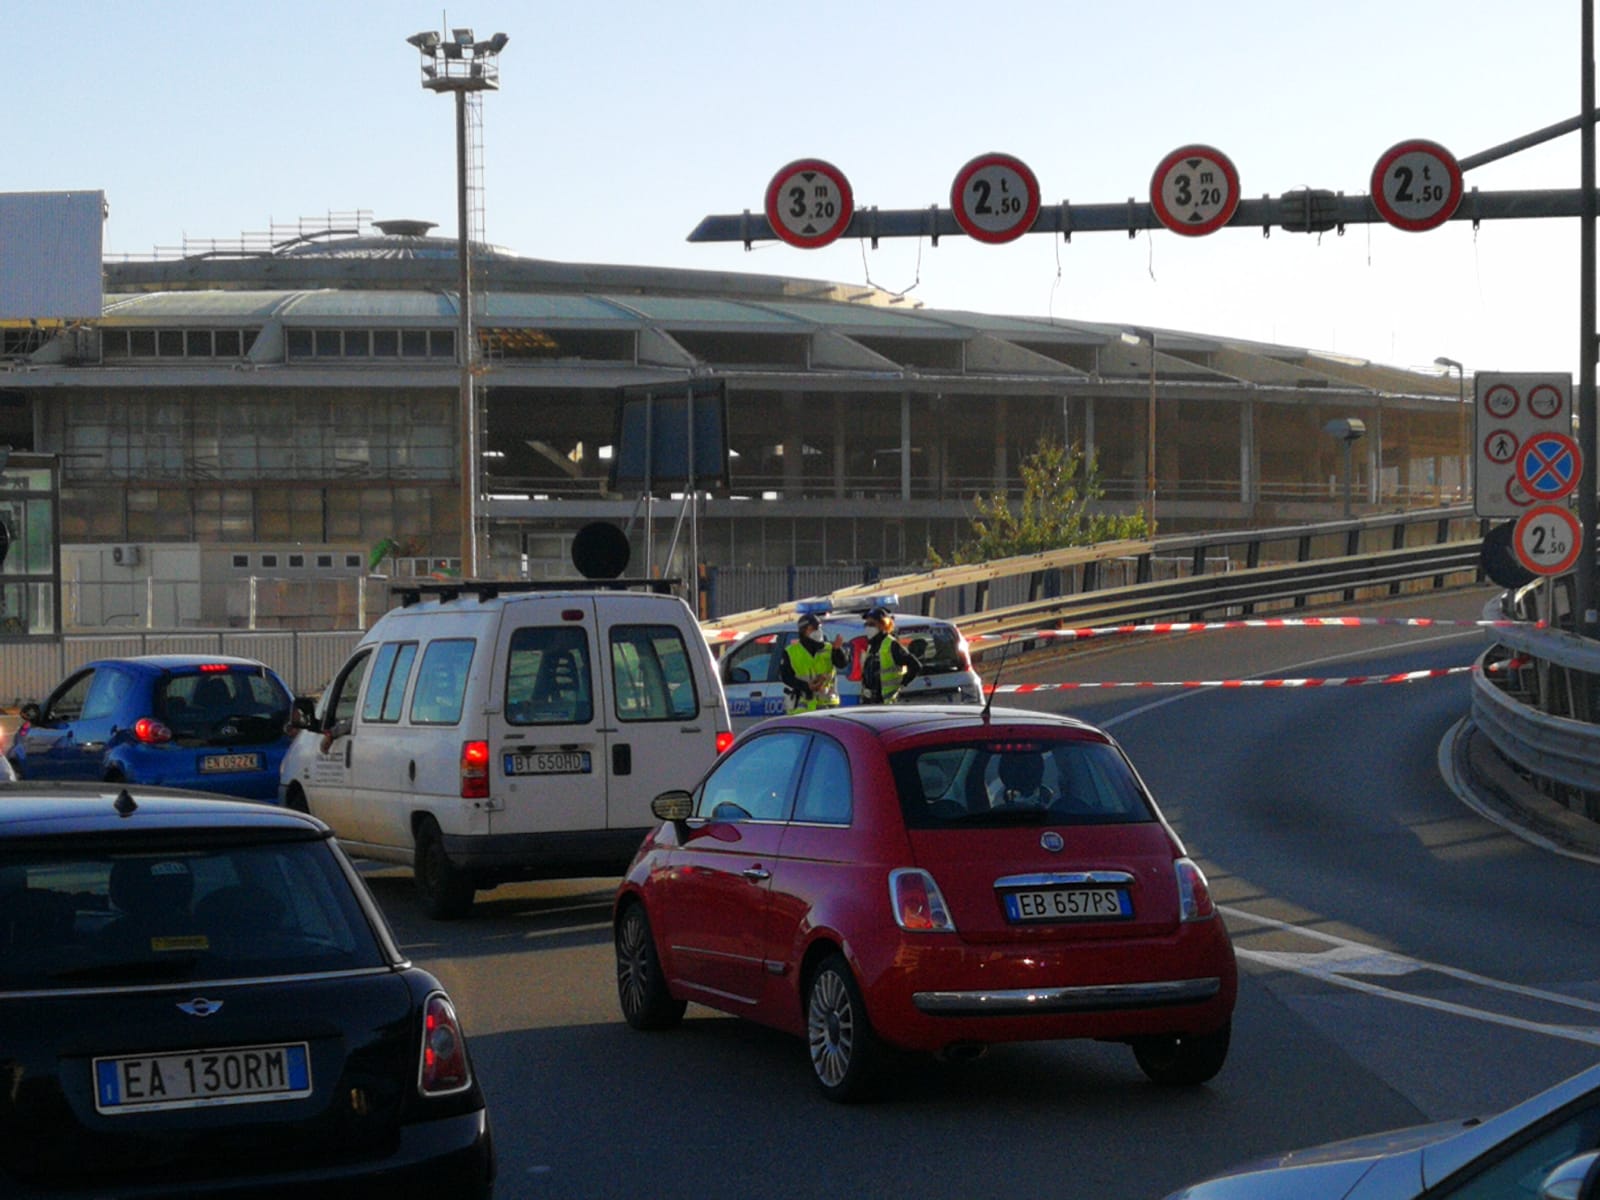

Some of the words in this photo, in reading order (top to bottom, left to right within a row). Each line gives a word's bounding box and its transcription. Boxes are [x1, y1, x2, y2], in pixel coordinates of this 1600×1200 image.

[206, 756, 220, 769] EN
[515, 756, 532, 771] BT
[537, 754, 581, 770] 650HD
[1019, 894, 1047, 916] EB
[1053, 891, 1118, 915] 657PS
[124, 1060, 167, 1099] EA
[184, 1051, 286, 1095] 130RM
